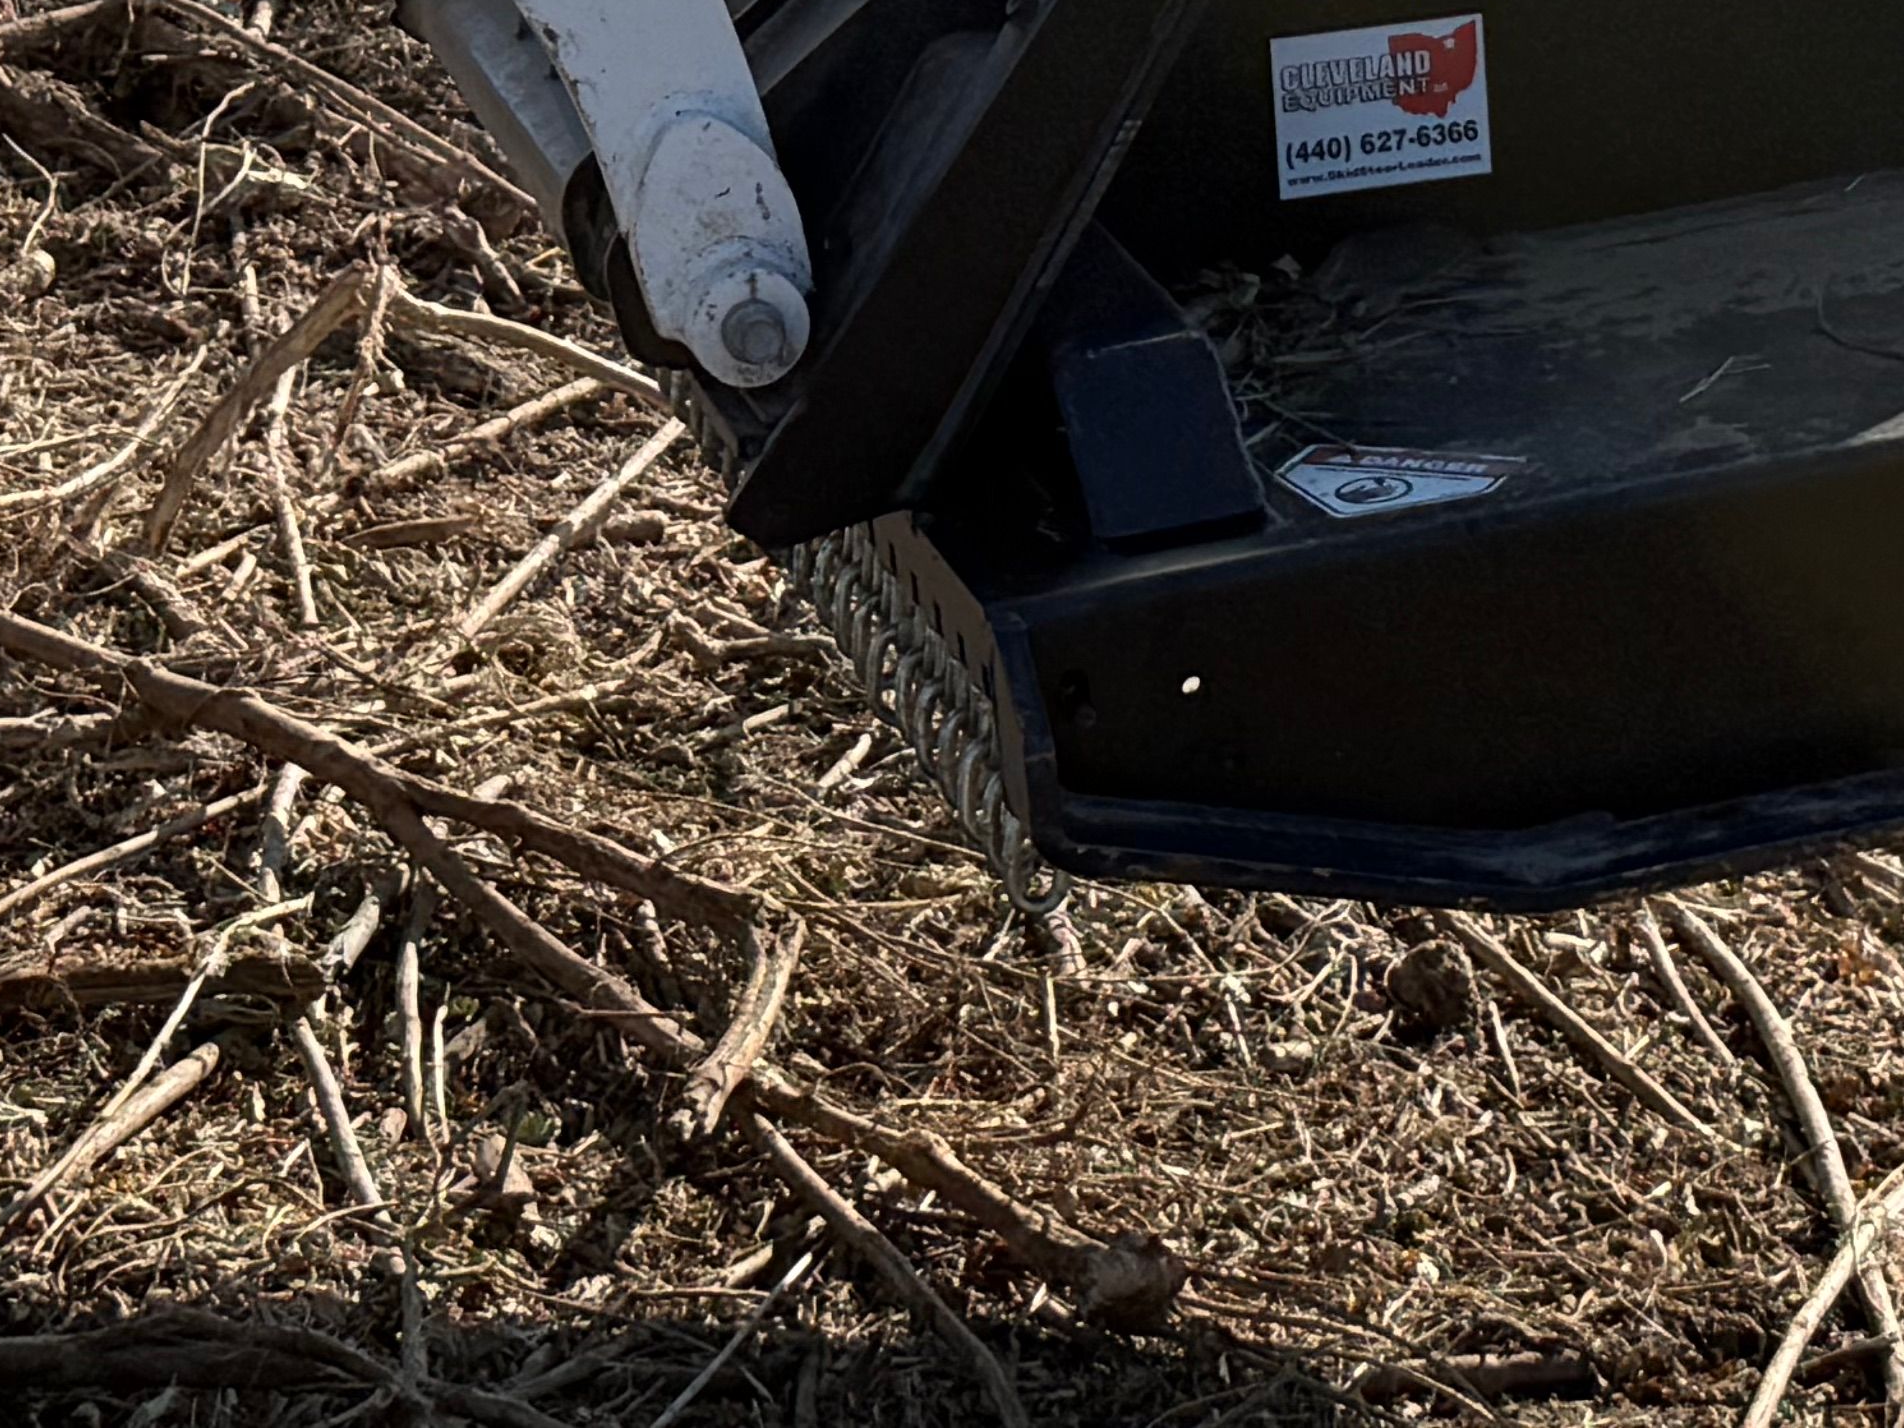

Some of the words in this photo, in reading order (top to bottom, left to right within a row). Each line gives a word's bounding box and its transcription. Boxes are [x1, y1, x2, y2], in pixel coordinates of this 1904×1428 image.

[1280, 49, 1432, 93] CLEVELAND
[1282, 77, 1431, 113] EQUIPMENT
[1285, 135, 1351, 170] (440)
[1359, 119, 1480, 155] 627-6366
[1359, 455, 1490, 474] DANGER
